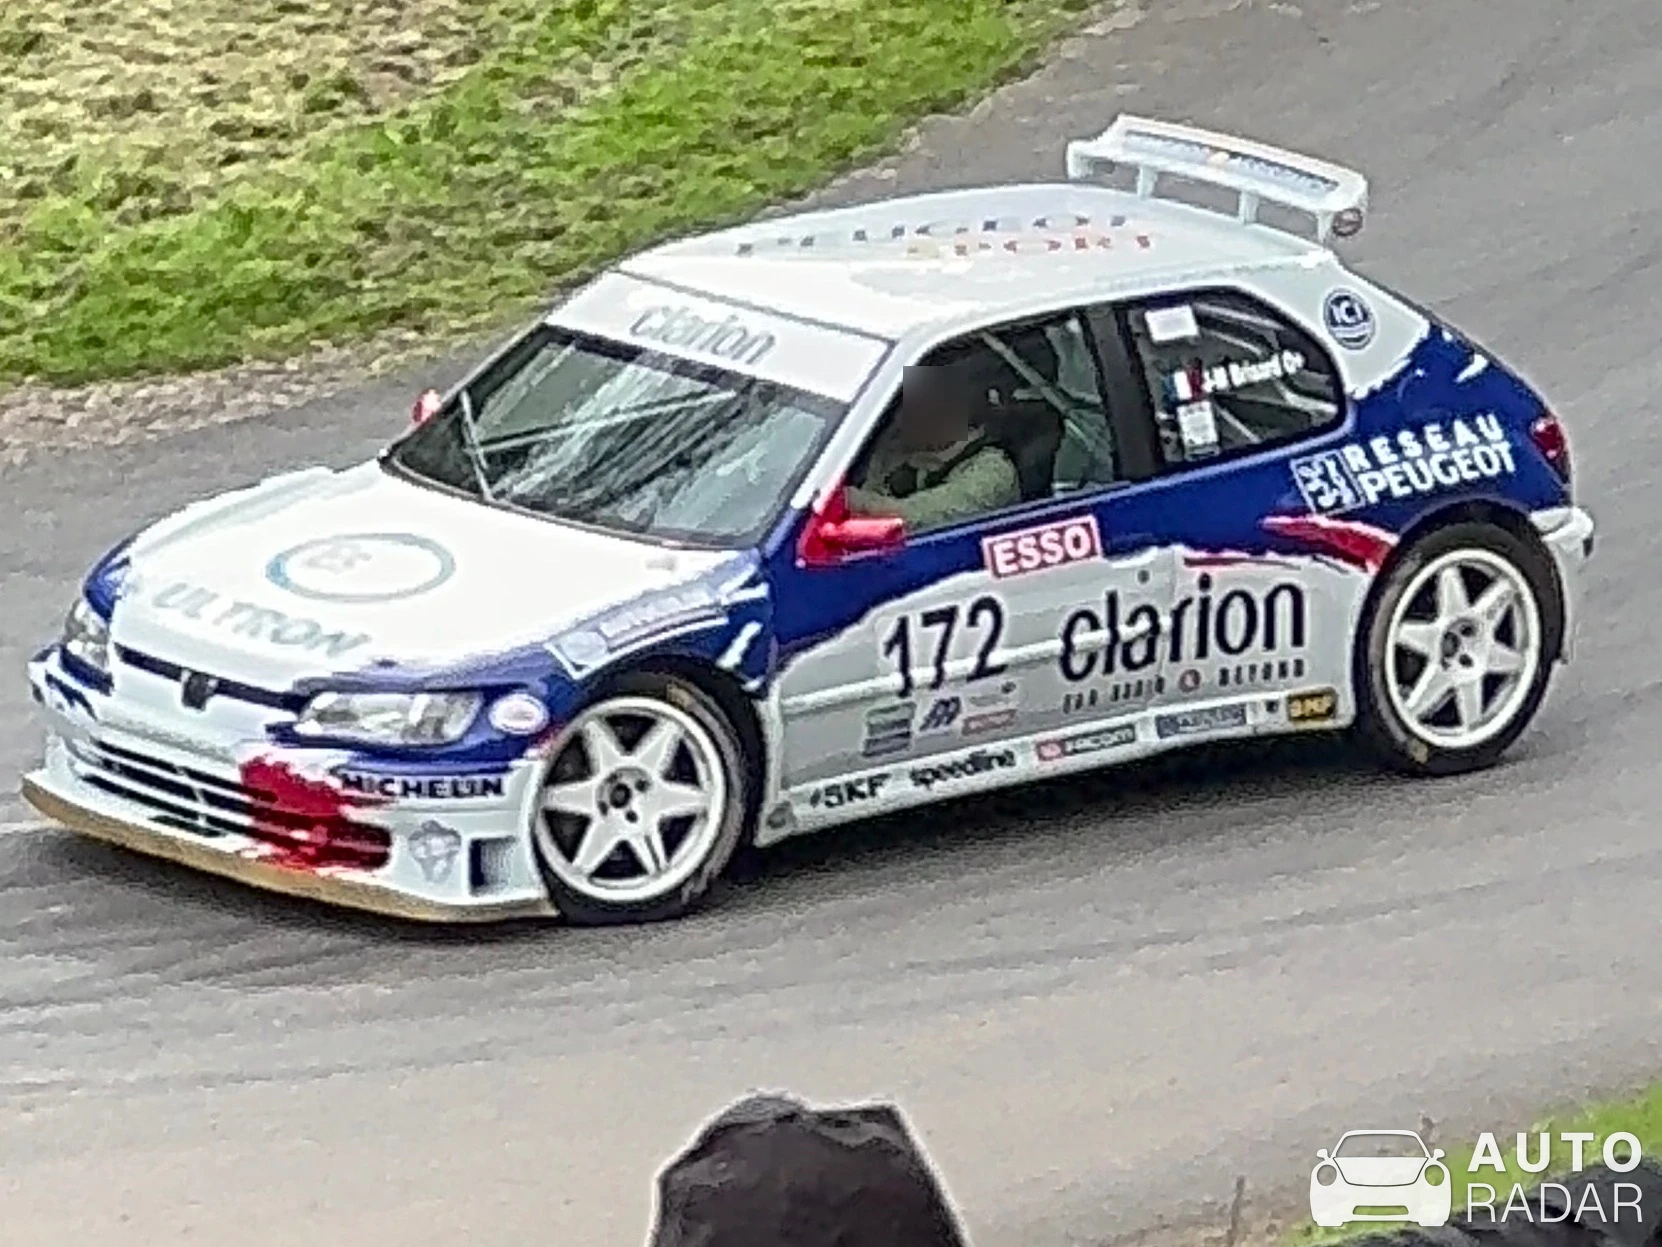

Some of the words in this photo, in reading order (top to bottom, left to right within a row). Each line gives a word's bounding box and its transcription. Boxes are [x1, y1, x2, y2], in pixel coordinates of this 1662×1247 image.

[628, 304, 777, 366] clarion
[1341, 413, 1504, 472] RESEAU
[1358, 440, 1516, 504] PEUGEOT
[992, 522, 1092, 573] ESSO
[151, 581, 373, 659] ULTRON
[883, 596, 1009, 699] 172
[1059, 572, 1306, 682] clarion
[341, 773, 506, 799] MICHELIN
